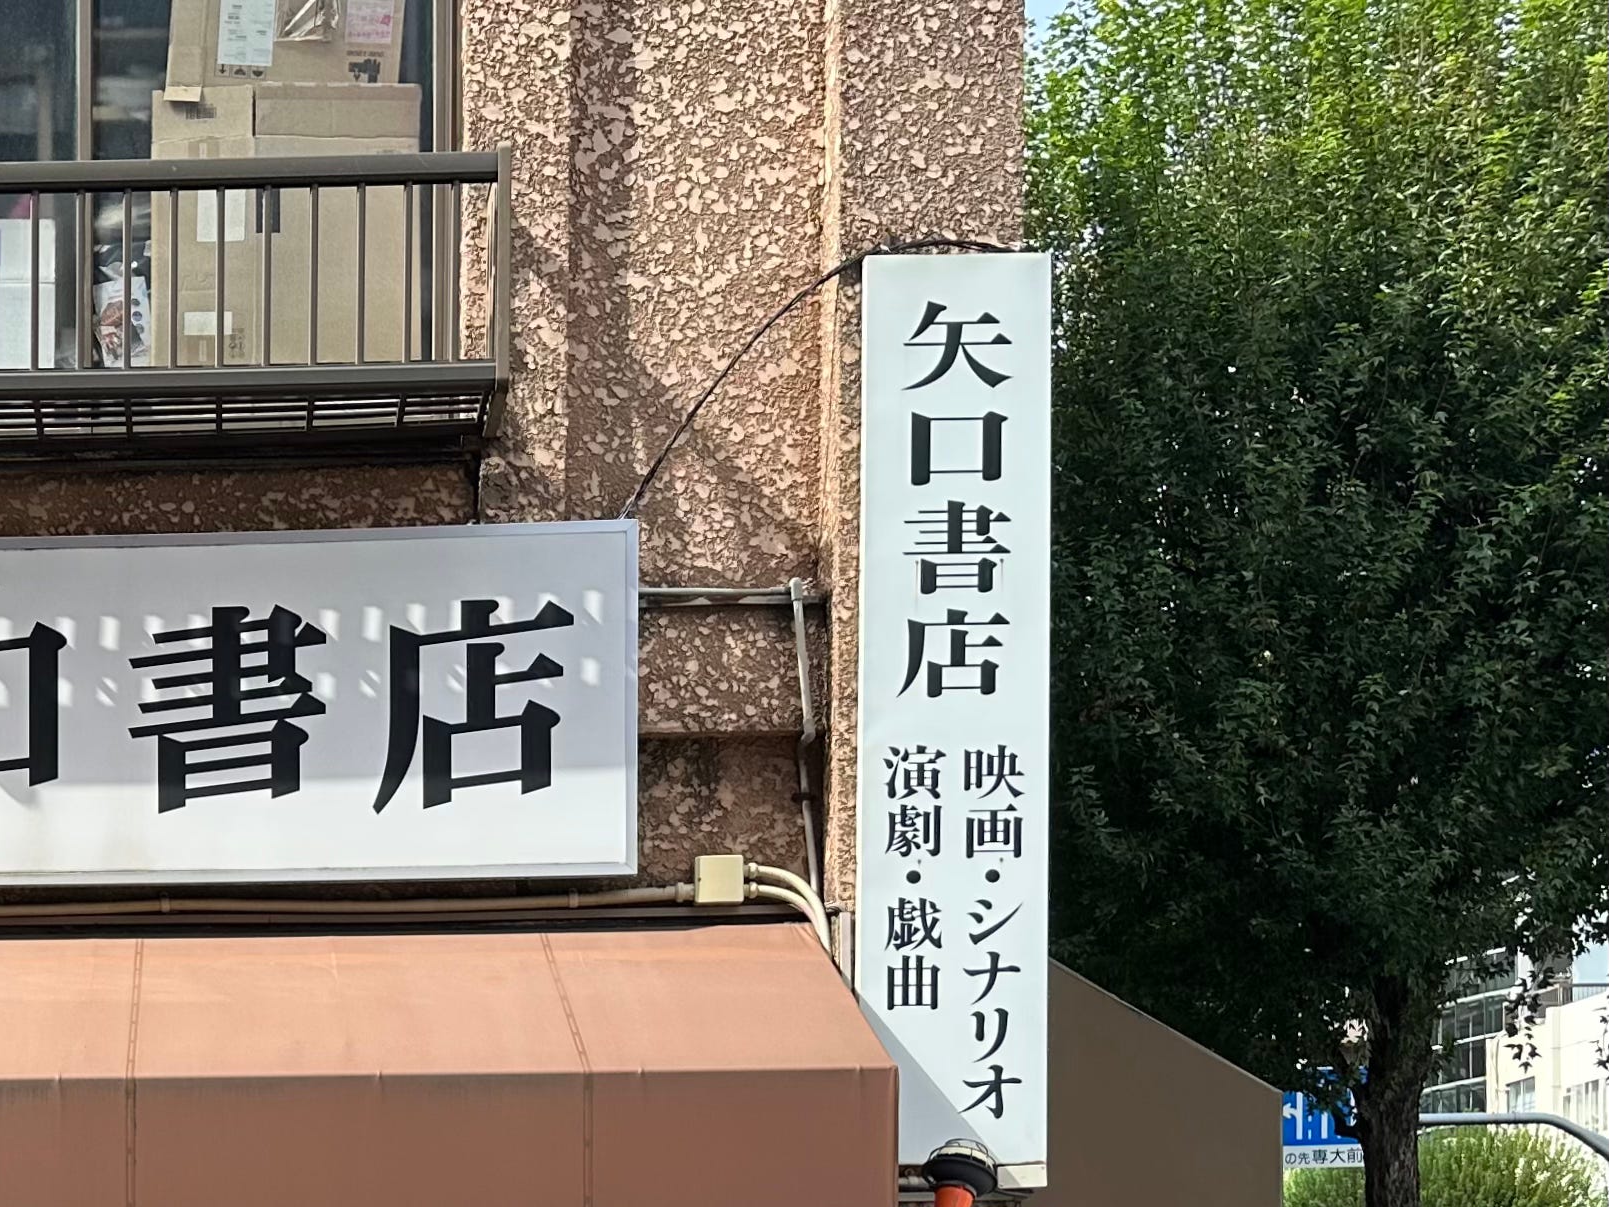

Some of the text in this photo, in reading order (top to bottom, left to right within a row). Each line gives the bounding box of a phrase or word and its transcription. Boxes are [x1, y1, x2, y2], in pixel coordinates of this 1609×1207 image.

[897, 301, 1015, 699] 矢口書店
[883, 744, 945, 1012] 演劇・戯曲
[962, 744, 1026, 1120] 映画・シナリオ
